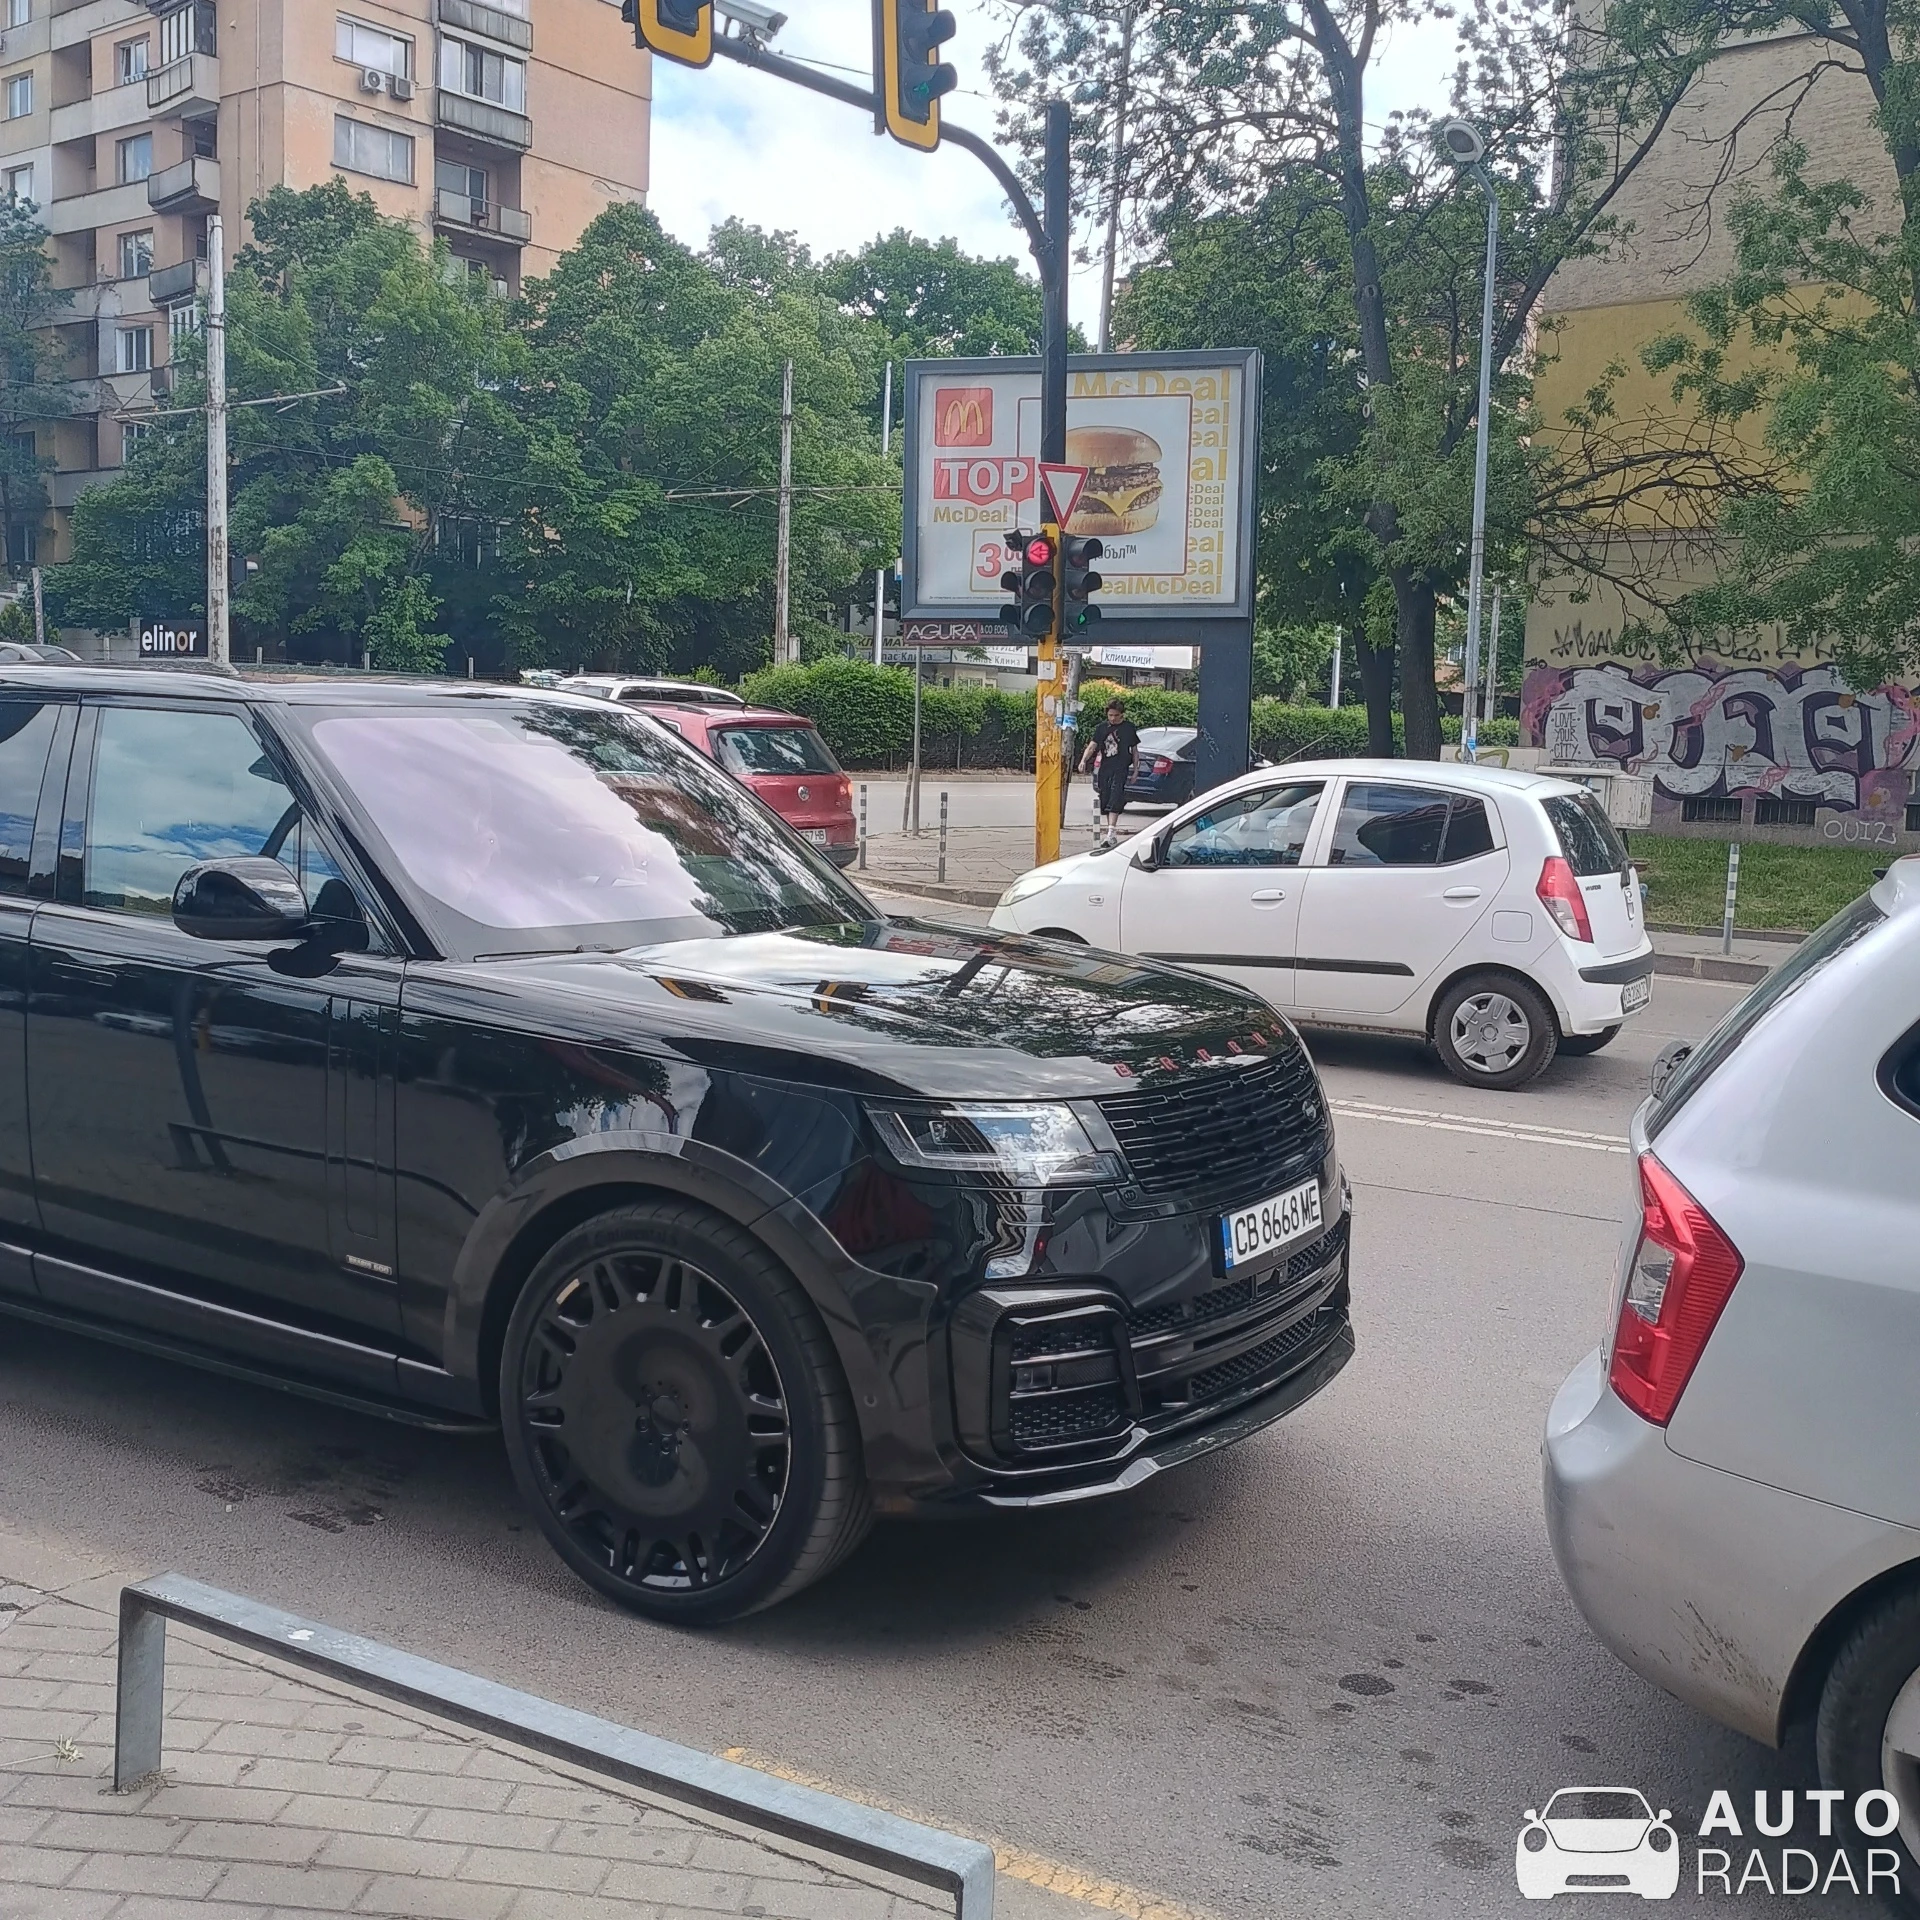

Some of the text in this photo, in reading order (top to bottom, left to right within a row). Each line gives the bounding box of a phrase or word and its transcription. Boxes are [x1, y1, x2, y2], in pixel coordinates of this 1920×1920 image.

[940, 460, 1029, 496] TOP
[933, 505, 1008, 523] McDeal
[976, 542, 1002, 578] 3
[141, 624, 198, 652] elinor
[906, 623, 977, 640] AGURA
[1104, 652, 1151, 666] КЛИМАТИЦИ
[1554, 712, 1577, 728] LOVE
[1554, 728, 1579, 742] YOUR
[1235, 1184, 1320, 1256] CB 8668 ME
